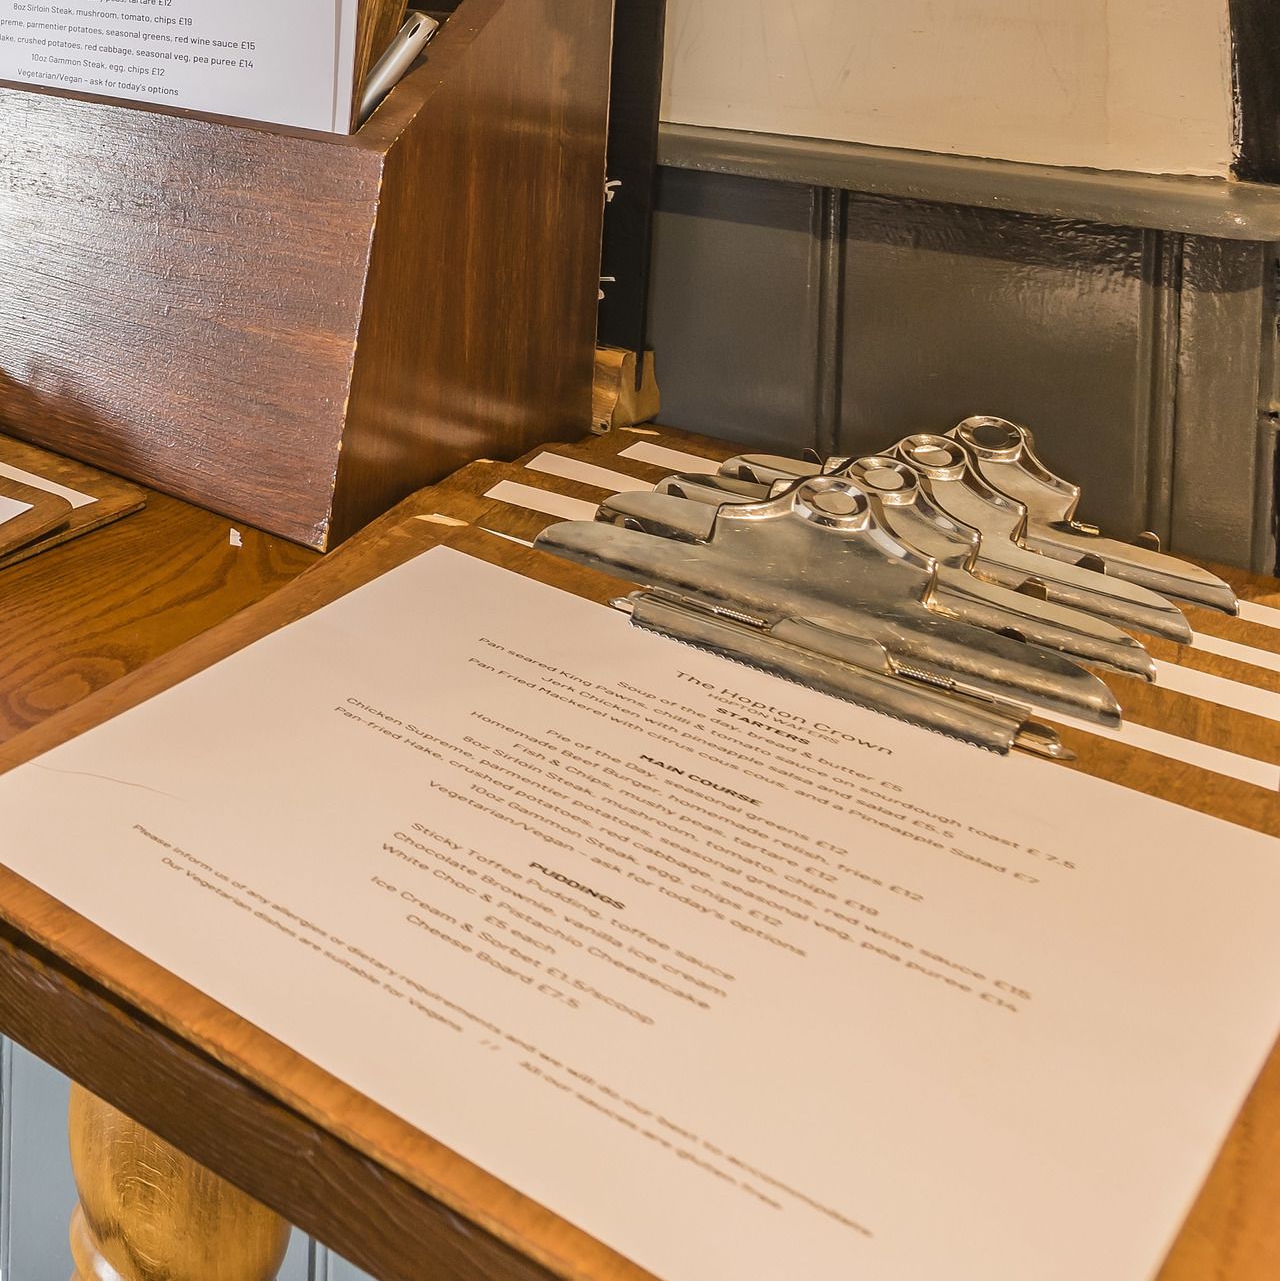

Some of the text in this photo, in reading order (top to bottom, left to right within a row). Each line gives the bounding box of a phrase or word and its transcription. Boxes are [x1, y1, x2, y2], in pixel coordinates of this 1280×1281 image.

[13, 3, 193, 26] 8oz Sirloin Steak, mushroom, tomato, chips £19
[27, 21, 67, 30] parmentier
[69, 24, 104, 36] potatoes,
[106, 29, 141, 39] seasonal
[143, 33, 173, 43] greens,
[175, 35, 189, 43] red
[191, 37, 211, 45] wine
[212, 39, 239, 48] sauce
[241, 41, 256, 50] £15
[18, 36, 46, 46] crushed
[48, 40, 83, 51] potatoes,
[85, 44, 97, 52] red
[99, 45, 134, 56] cabbage,
[136, 49, 172, 60] seasonal
[174, 54, 192, 63] veg,
[193, 56, 209, 64] pea
[211, 57, 237, 66] puree
[239, 59, 254, 68] £14
[32, 53, 165, 76] 10oz Gammon Steak, egg, chips £12
[90, 78, 103, 86] ask
[105, 79, 116, 87] for
[148, 86, 179, 96] options
[676, 671, 893, 755] The Hopton Crown
[716, 707, 810, 745] STARTERS
[640, 755, 764, 807] MAIN COURSE
[529, 861, 625, 910] PUDDINGS
